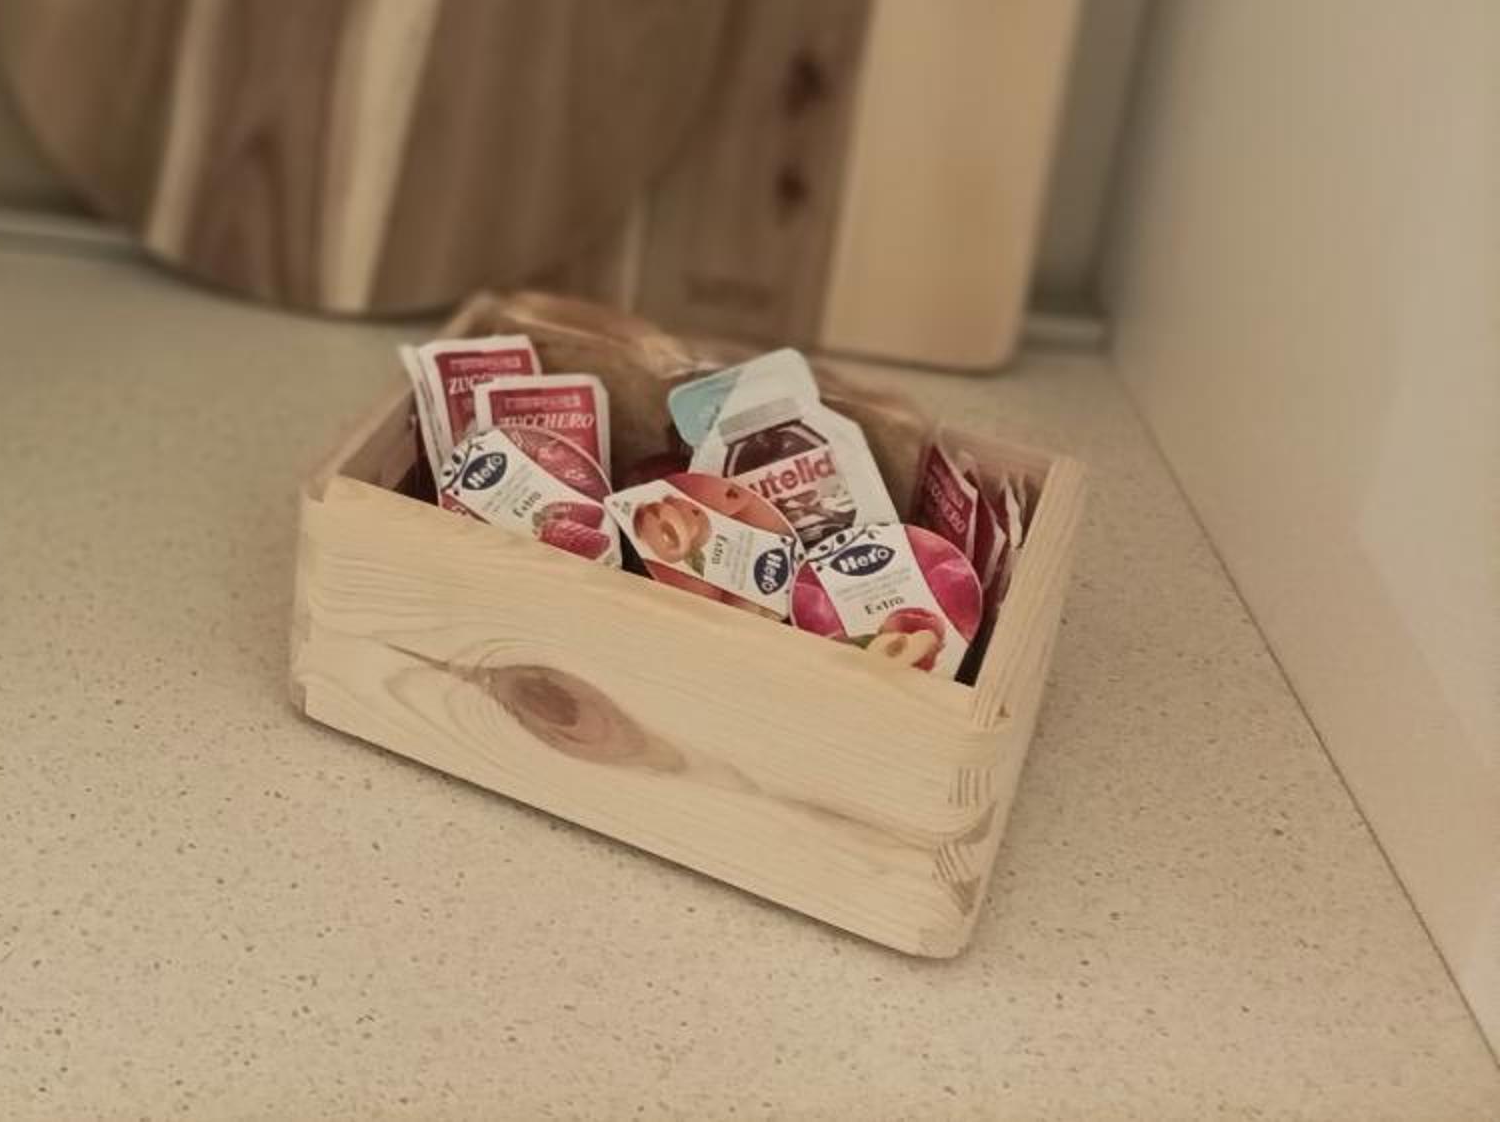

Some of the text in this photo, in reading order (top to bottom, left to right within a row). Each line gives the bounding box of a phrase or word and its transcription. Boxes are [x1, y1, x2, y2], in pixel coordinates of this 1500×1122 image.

[467, 455, 503, 489] Hero
[749, 453, 837, 498] utella
[761, 552, 783, 592] Hero
[838, 547, 890, 573] Hero
[864, 595, 905, 615] Extra
